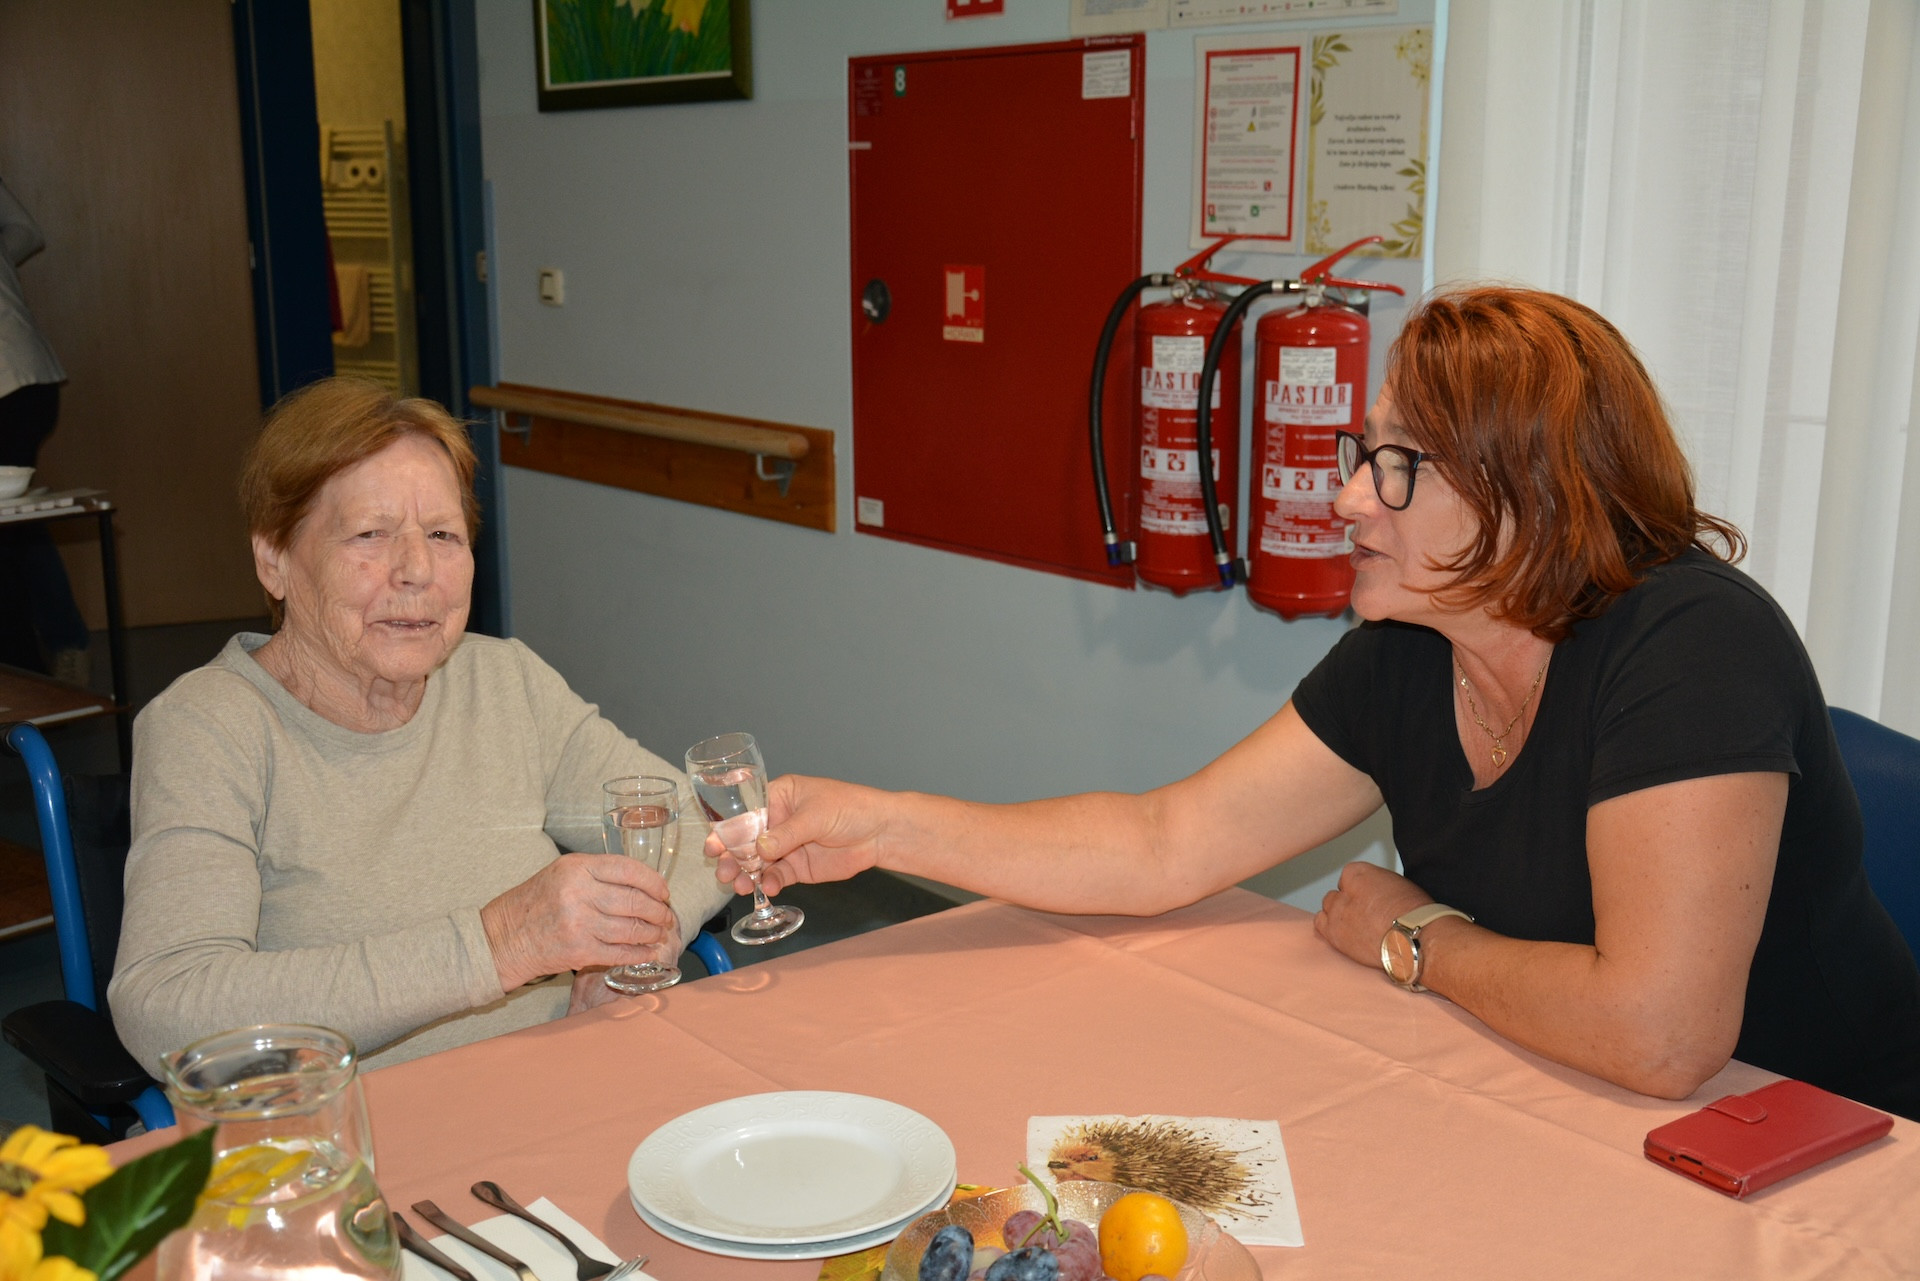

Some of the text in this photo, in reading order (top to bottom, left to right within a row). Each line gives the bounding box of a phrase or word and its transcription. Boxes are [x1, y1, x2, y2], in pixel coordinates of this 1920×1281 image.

[895, 69, 906, 92] 8
[1145, 370, 1203, 391] PASTO
[1271, 383, 1346, 405] PASTOR
